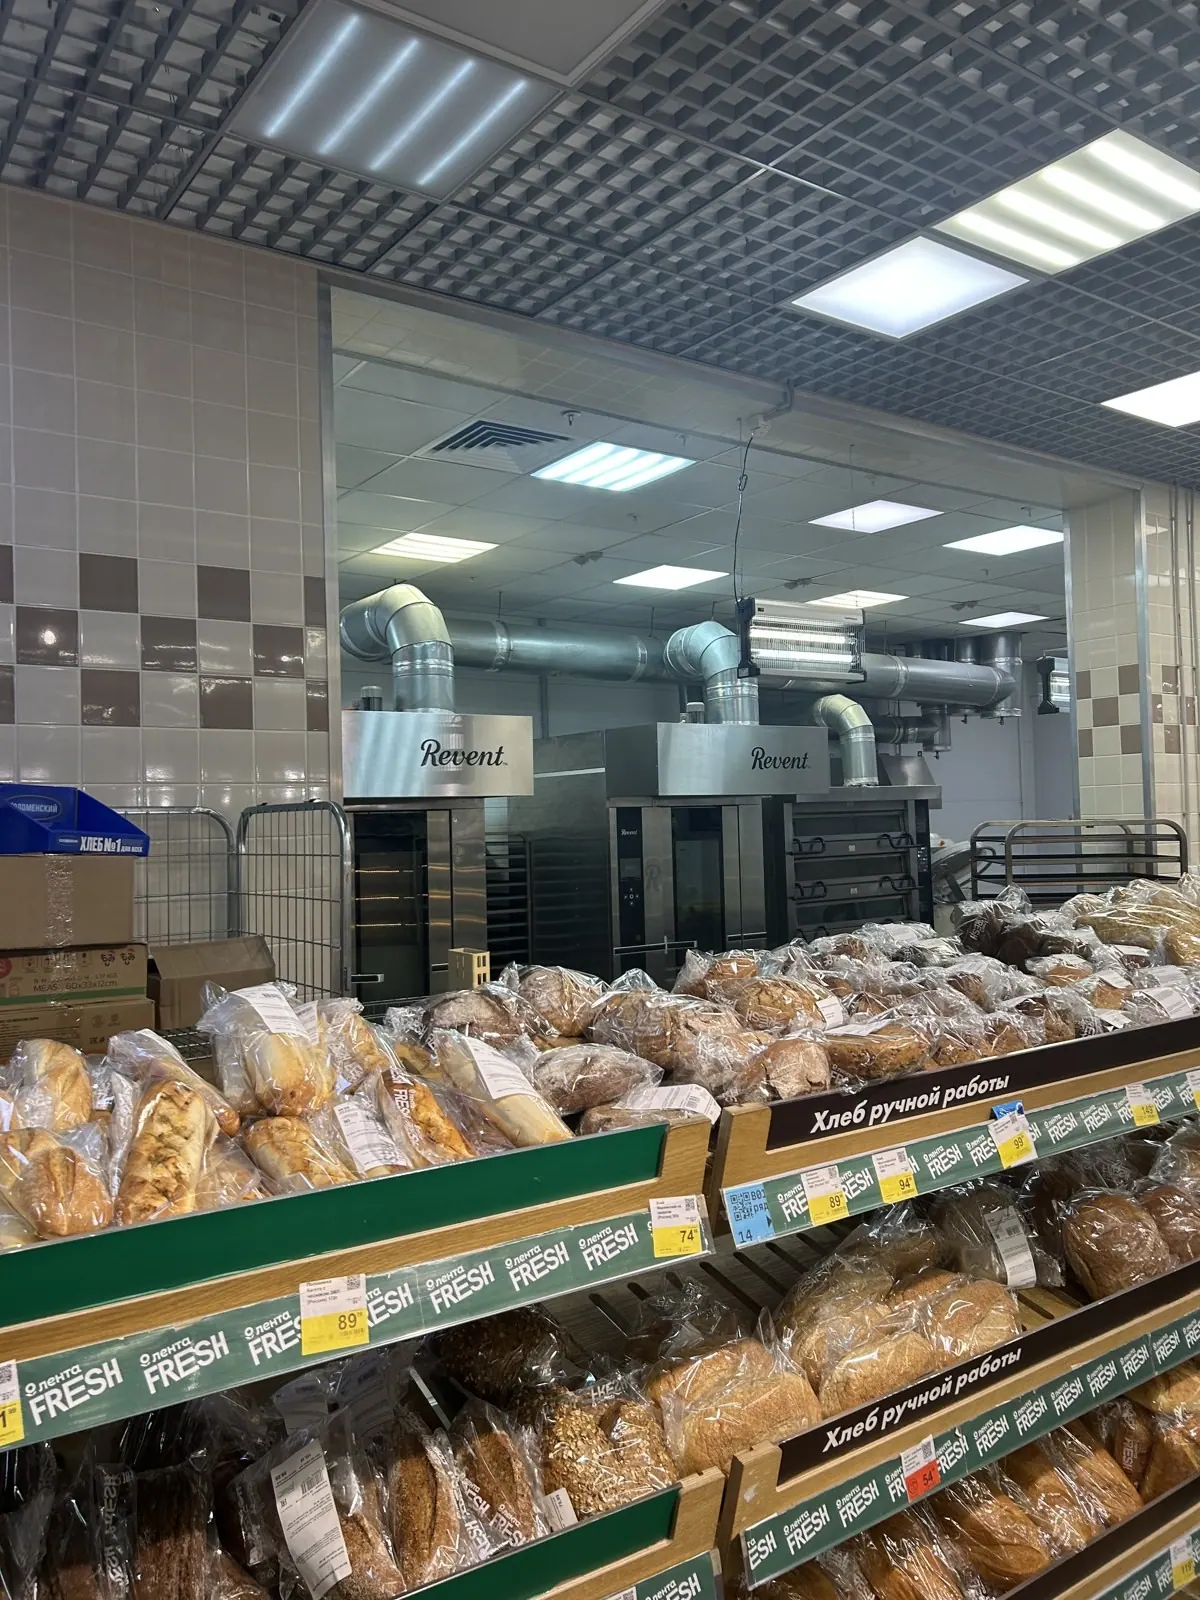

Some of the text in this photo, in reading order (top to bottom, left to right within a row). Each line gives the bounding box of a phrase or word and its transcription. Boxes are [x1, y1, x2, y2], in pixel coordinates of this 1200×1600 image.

[420, 738, 504, 767] Revent
[751, 746, 809, 770] Revent
[80, 837, 103, 852] ХЛЕБ
[104, 838, 122, 852] №1
[810, 1074, 1010, 1134] Хлеб ручной работы
[1083, 1103, 1113, 1134] FRESH
[1013, 1137, 1024, 1149] 99
[1047, 1112, 1078, 1145] FRESH
[926, 1143, 963, 1180] FRESH
[970, 1137, 998, 1167] FRES
[899, 1178, 911, 1190] 94
[781, 1190, 809, 1223] FRE
[829, 1195, 841, 1208] 89
[582, 1223, 639, 1272] FRESH
[586, 1225, 613, 1246] лента
[680, 1229, 694, 1243] 74
[738, 1229, 753, 1244] 14
[508, 1241, 570, 1292] FRESH
[513, 1245, 542, 1266] лента
[429, 1261, 495, 1315] FRESH
[435, 1265, 465, 1287] лента
[255, 1310, 292, 1336] лента
[338, 1313, 357, 1331] 89
[152, 1336, 193, 1363] лента
[1122, 1344, 1150, 1380] FRESH
[1154, 1329, 1180, 1365] FRESH
[143, 1330, 230, 1395] FRESH
[29, 1358, 123, 1427] FRESH
[38, 1364, 82, 1392] лента
[1088, 1360, 1118, 1398] FRESH
[822, 1348, 1022, 1453] Хлеб ручной работы
[1053, 1377, 1084, 1416] FRESH
[978, 1419, 994, 1438] лента
[1015, 1395, 1048, 1437] FRESH
[975, 1414, 1010, 1457] FRESH
[922, 1470, 934, 1486] 54
[838, 1479, 880, 1528] FRESH
[841, 1485, 861, 1505] лента
[786, 1504, 831, 1556] FRESH
[789, 1510, 810, 1531] лента
